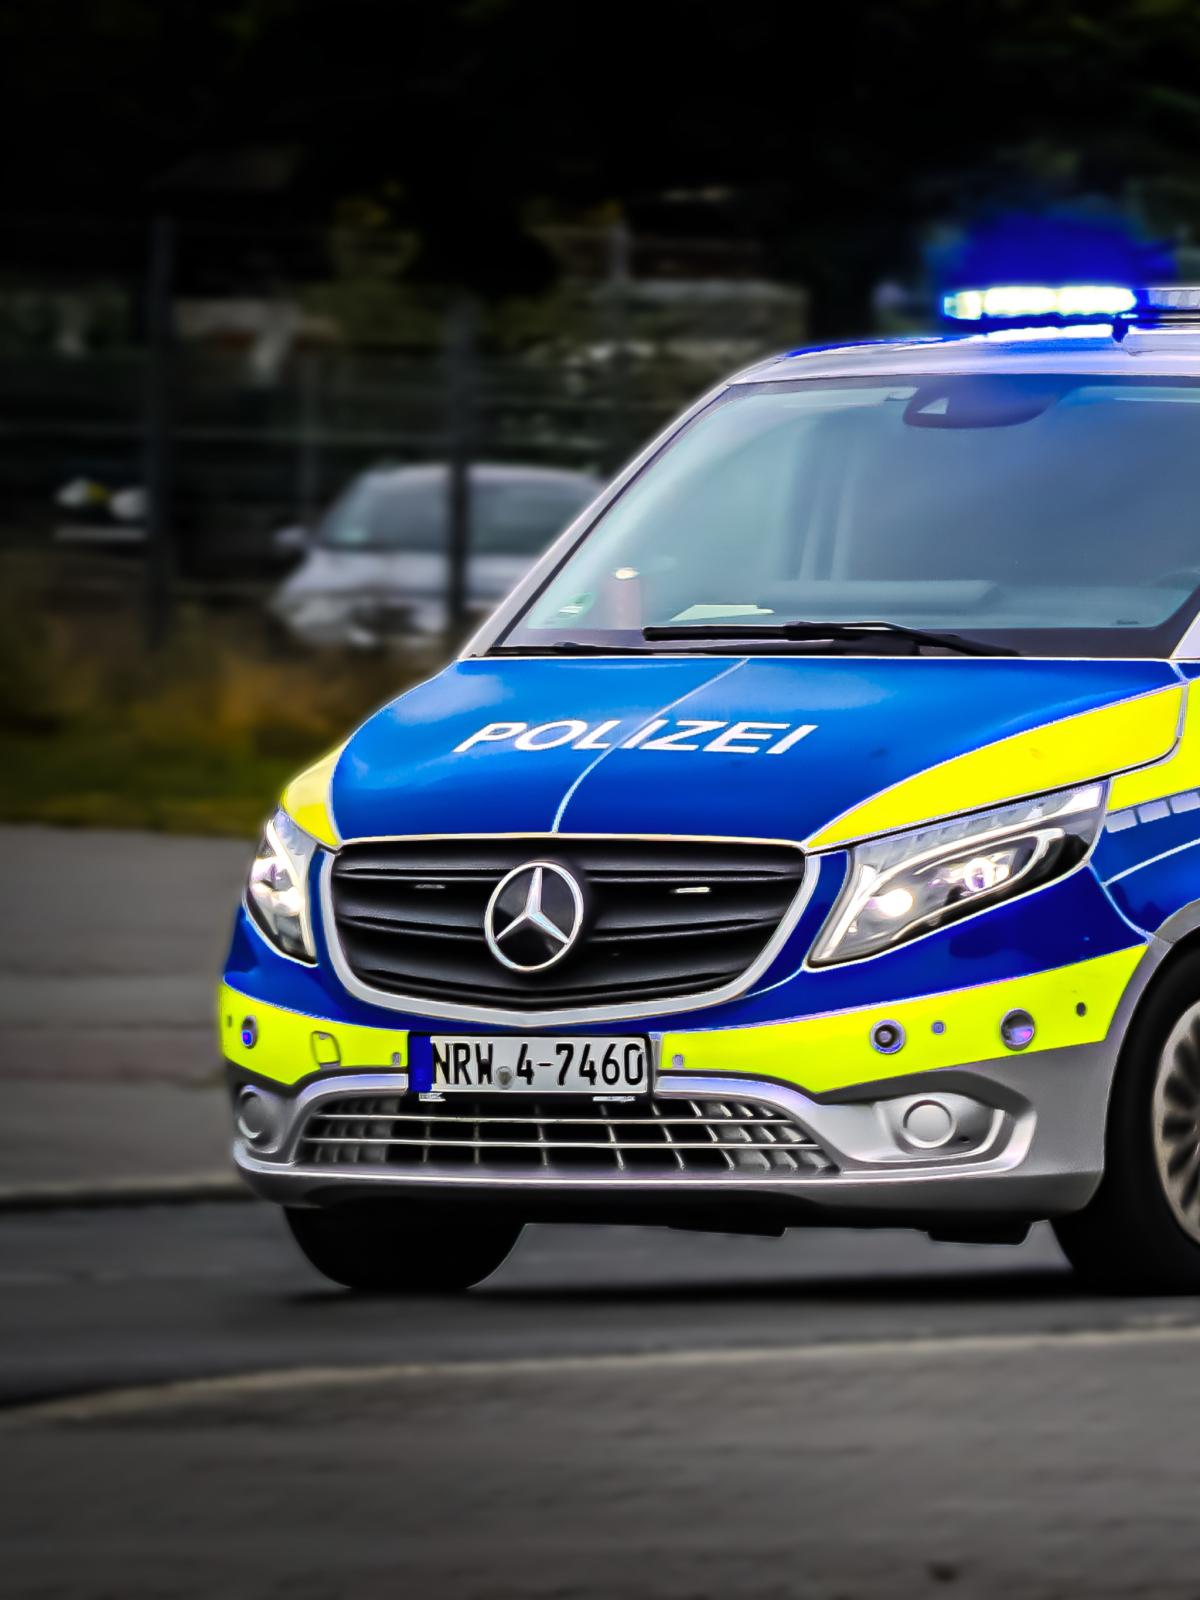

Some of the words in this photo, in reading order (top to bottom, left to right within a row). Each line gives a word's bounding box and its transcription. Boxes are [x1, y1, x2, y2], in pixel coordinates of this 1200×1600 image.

[452, 719, 819, 754] POLIZEI
[432, 1042, 494, 1086] NRW
[516, 1042, 644, 1086] 4-7460
